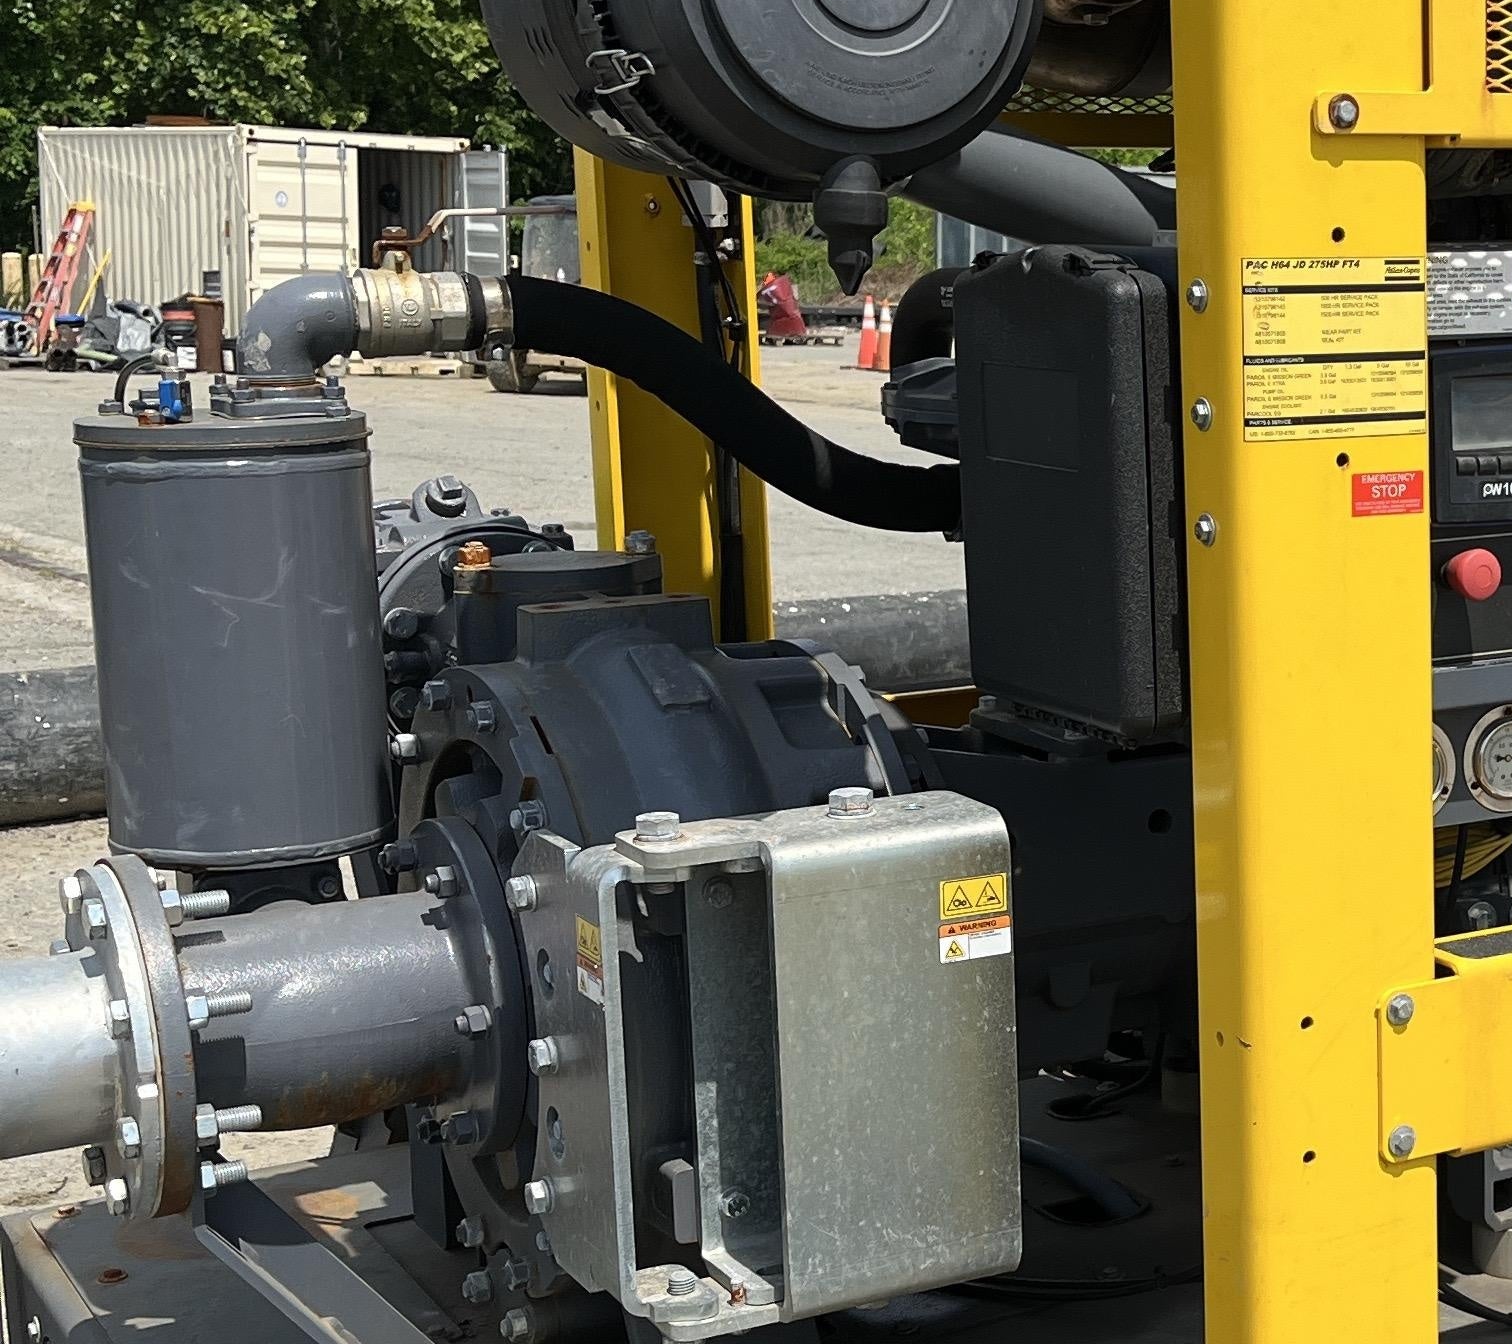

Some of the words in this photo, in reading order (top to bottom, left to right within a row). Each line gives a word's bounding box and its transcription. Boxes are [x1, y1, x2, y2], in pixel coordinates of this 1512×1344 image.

[1245, 260, 1268, 269] PAC
[1270, 260, 1290, 269] H64
[1308, 260, 1340, 268] 275HP
[1341, 260, 1360, 268] FT4
[1360, 473, 1416, 484] EMERGENCY
[1371, 484, 1407, 499] STOP
[958, 919, 997, 932] WARNING
